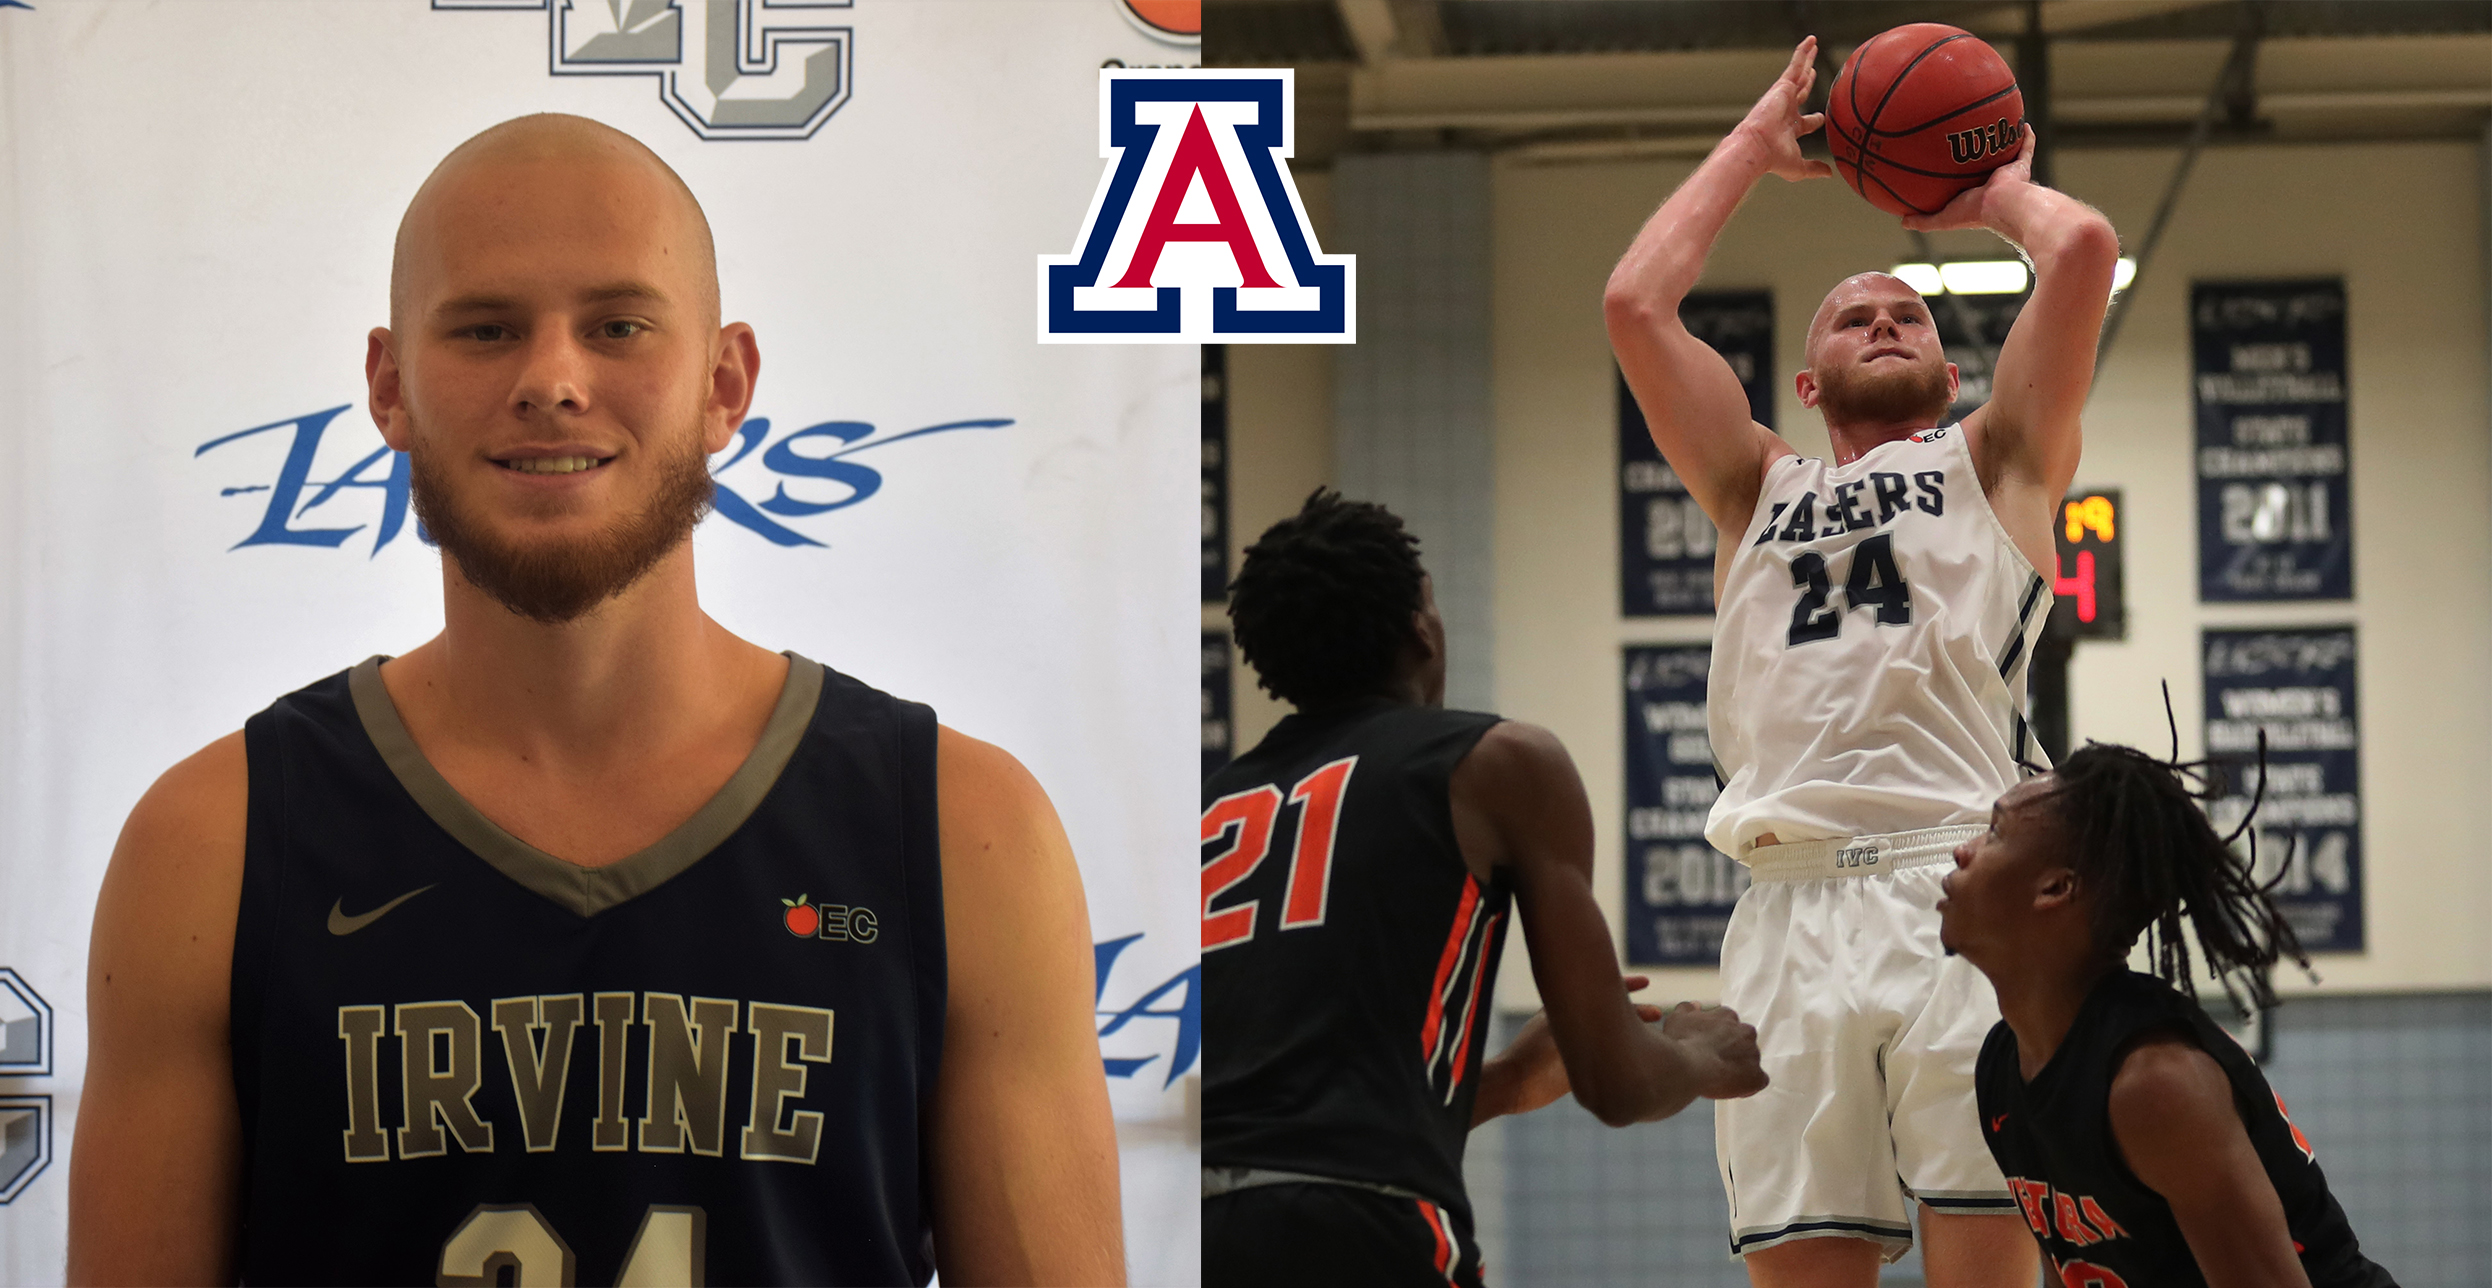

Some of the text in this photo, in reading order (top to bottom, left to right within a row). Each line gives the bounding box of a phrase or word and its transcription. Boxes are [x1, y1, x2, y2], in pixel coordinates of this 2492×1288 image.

[1785, 531, 1913, 650] 24
[1201, 754, 1359, 953] 21
[1837, 846, 1879, 868] IVC
[338, 992, 835, 1165] IRVINE
